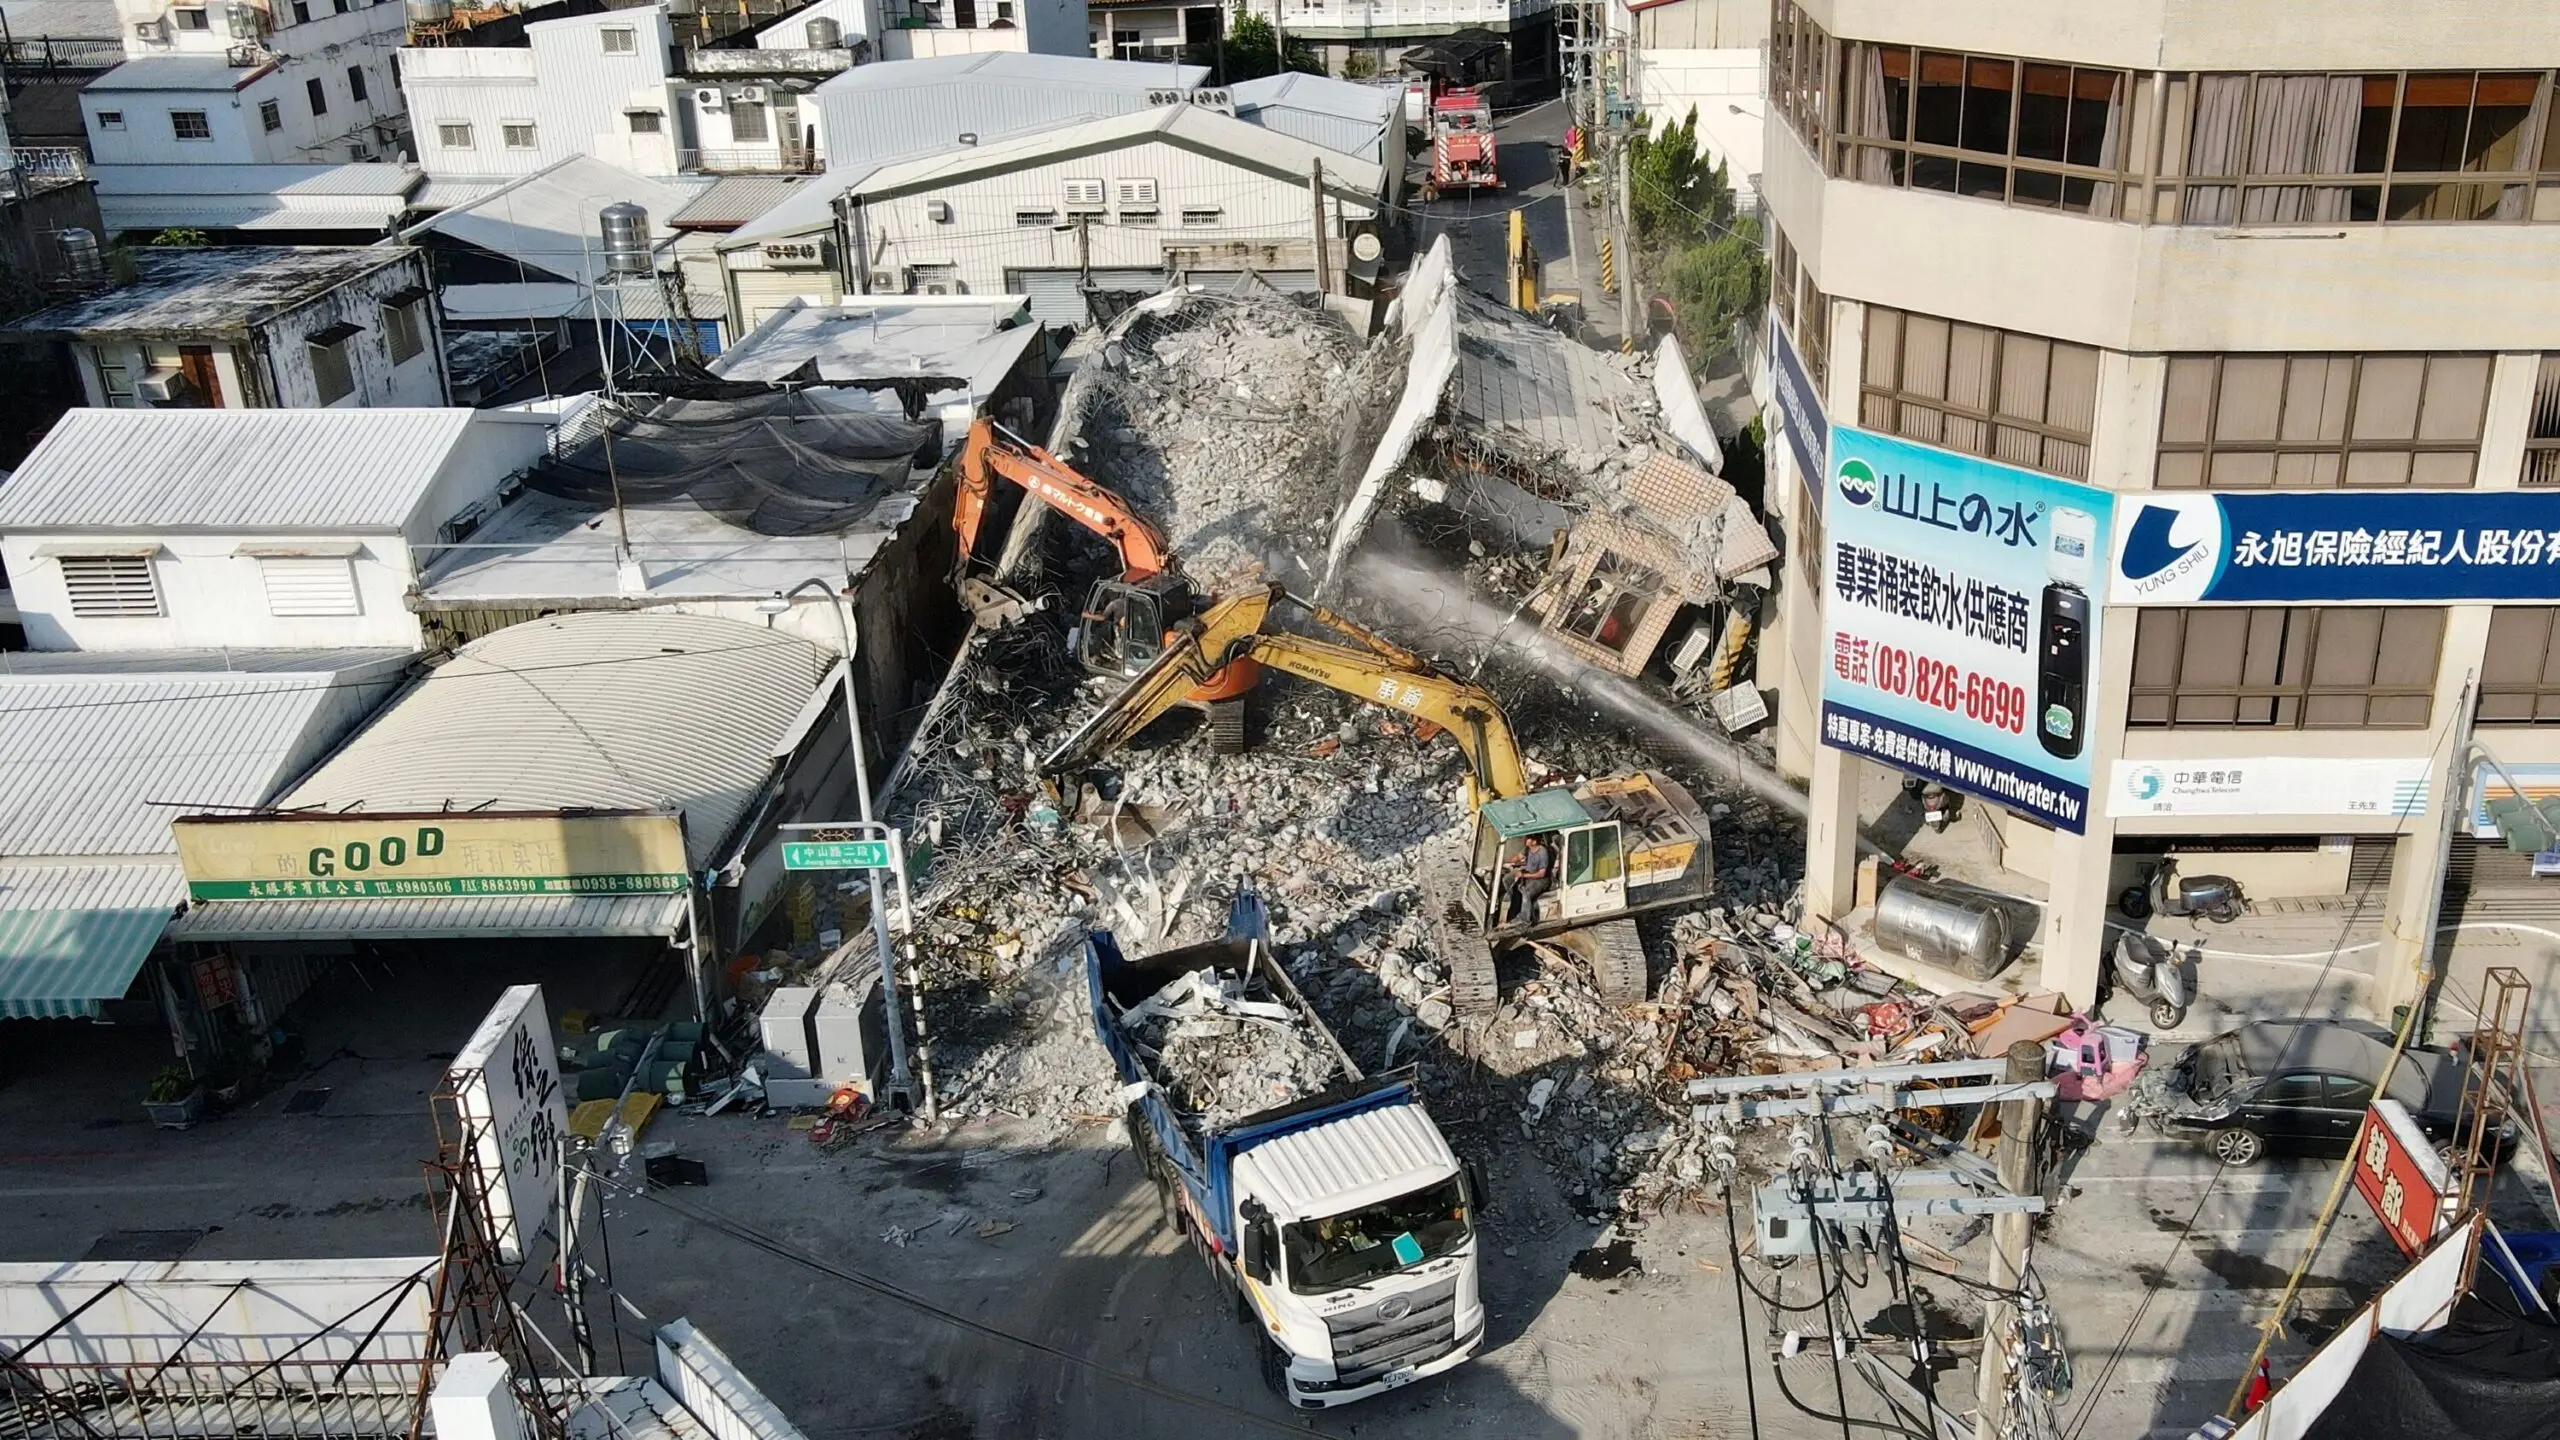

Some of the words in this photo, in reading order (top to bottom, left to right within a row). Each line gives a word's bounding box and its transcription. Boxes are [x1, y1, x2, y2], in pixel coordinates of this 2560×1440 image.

[1882, 474, 2039, 547] 山上の水
[2134, 569, 2176, 597] YUNG
[2179, 545, 2210, 576] SHIU
[1835, 541, 2030, 654] 專業桶裝飲水供應商
[1288, 659, 1332, 680] KOMATSU
[1954, 755, 2081, 822] www.mtwater.tw
[2174, 770, 2243, 785] 中華電信
[277, 854, 298, 876] 的
[309, 827, 444, 877] GOOD
[803, 845, 869, 858] 中山路二段
[1323, 1300, 1357, 1313] HINO
